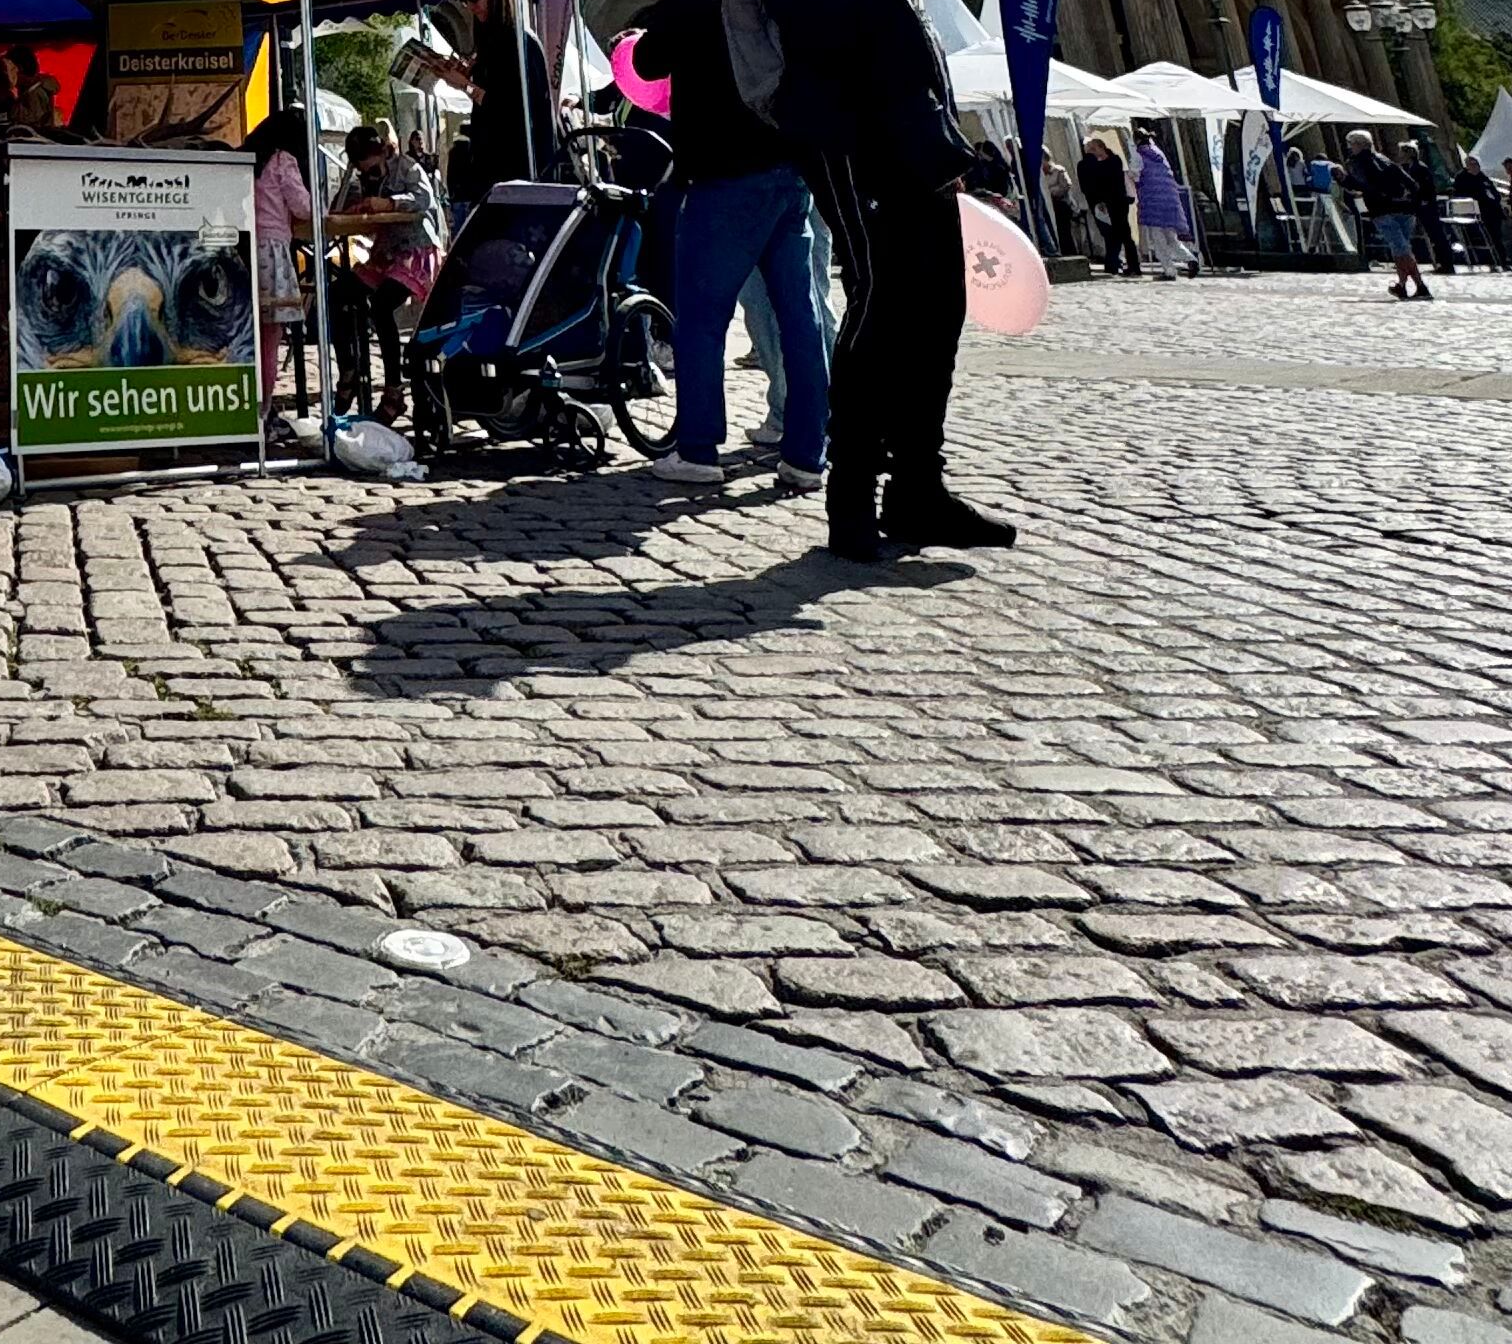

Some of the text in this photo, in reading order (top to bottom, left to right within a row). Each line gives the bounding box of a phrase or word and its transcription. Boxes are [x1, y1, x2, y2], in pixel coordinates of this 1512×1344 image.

[119, 51, 234, 72] Deisterkreisel
[82, 190, 189, 204] WISENTGEHEGE
[23, 373, 250, 419] Wir sehen uns!
